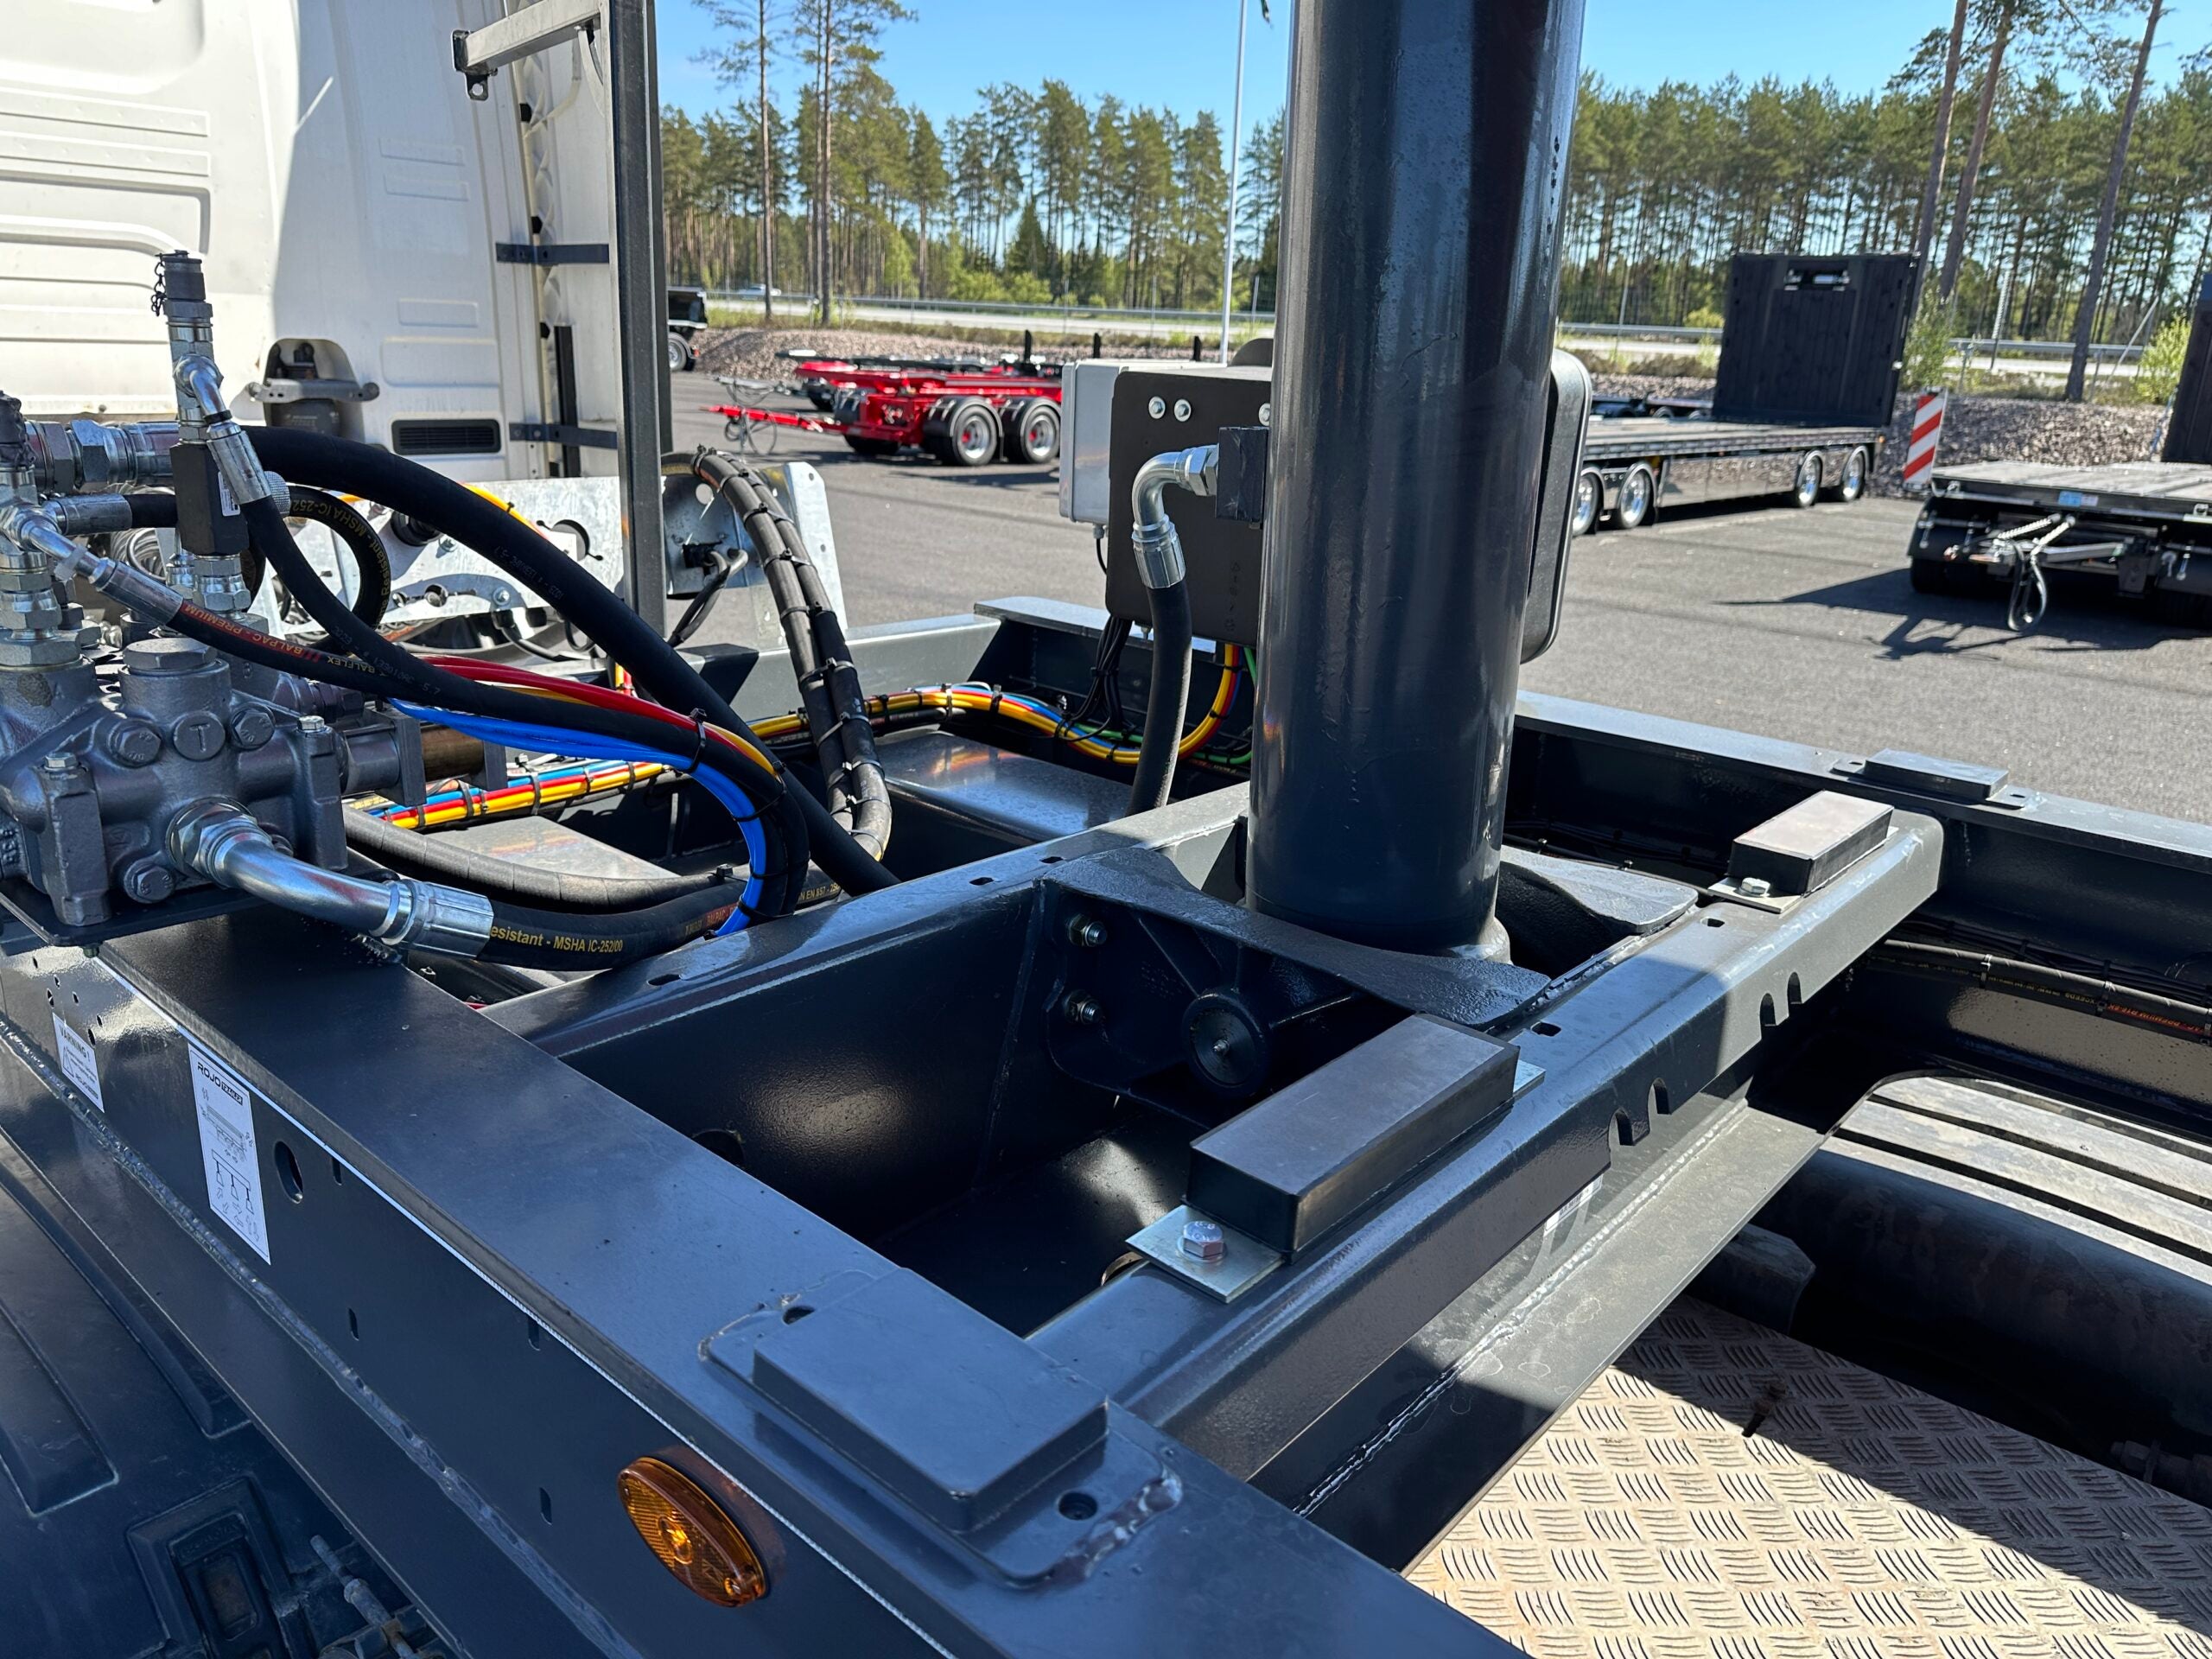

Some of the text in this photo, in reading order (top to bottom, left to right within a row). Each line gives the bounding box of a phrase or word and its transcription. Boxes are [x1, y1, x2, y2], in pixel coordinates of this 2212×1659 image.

[332, 508, 368, 537] MSHA
[369, 540, 390, 596] Resistant
[185, 604, 243, 634] PREMIUM
[251, 634, 303, 655] BALPAC
[327, 655, 376, 674] BALFLEX
[189, 723, 211, 753] T
[553, 936, 586, 952] MSHA
[587, 939, 624, 953] IC-252/00
[197, 1061, 243, 1106] ROJO TRAILER
